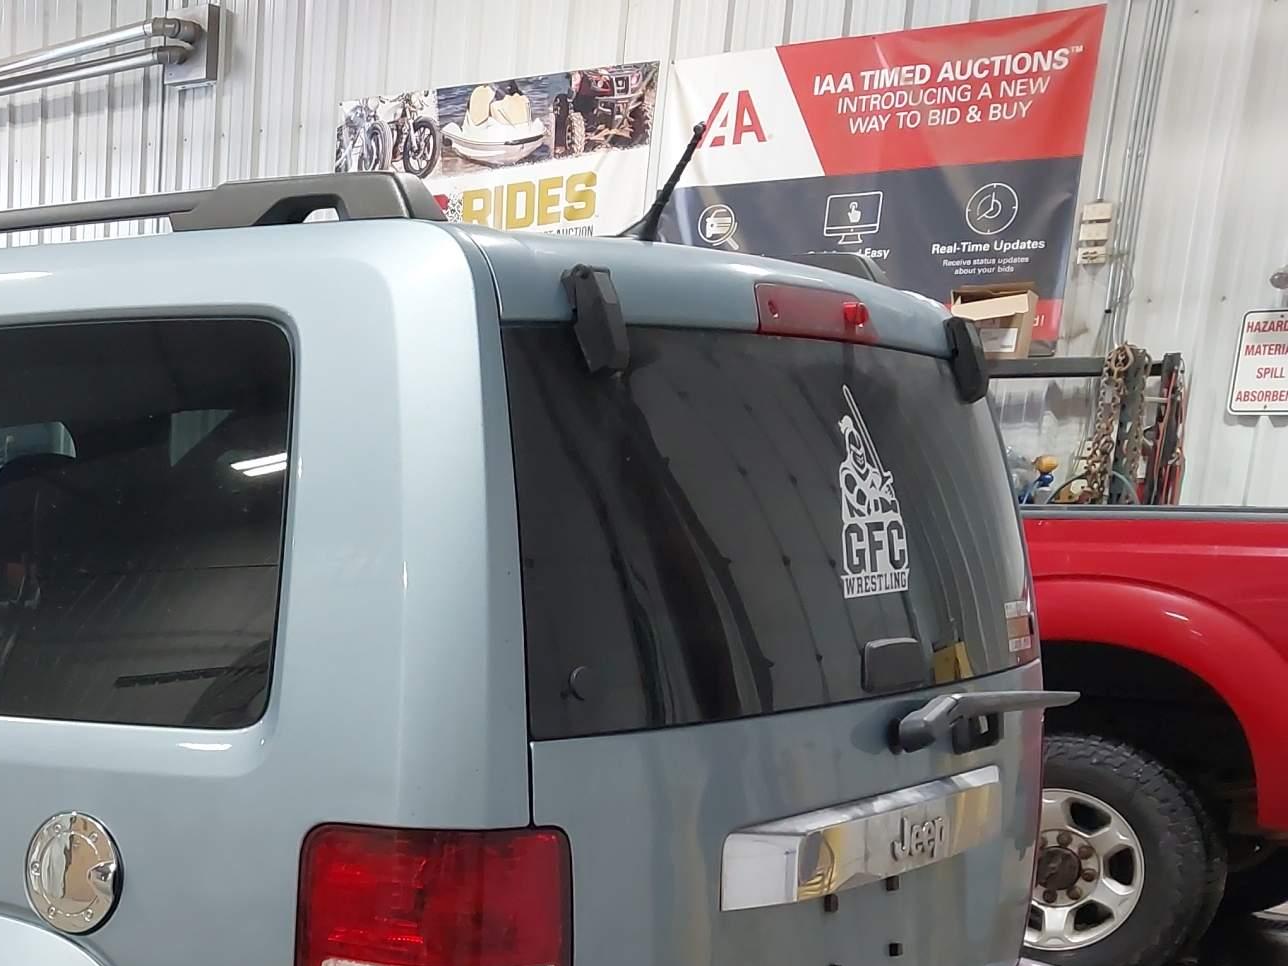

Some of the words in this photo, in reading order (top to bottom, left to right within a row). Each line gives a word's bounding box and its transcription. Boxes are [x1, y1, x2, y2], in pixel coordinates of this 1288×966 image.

[813, 72, 854, 96] IAA
[860, 64, 931, 91] TIMED
[837, 84, 972, 114] INTRODUCING
[977, 82, 992, 100] A
[999, 76, 1050, 98] NEW
[849, 114, 891, 134] WAY
[896, 111, 921, 129] TO
[927, 107, 961, 126] BID
[966, 105, 981, 124] &
[988, 101, 1032, 121] BUY
[463, 170, 598, 232] RIDES
[864, 247, 890, 260] Easy
[931, 241, 991, 255] Real-Time
[993, 239, 1046, 253] Updates
[942, 258, 972, 267] Receive
[972, 258, 996, 266] status
[997, 256, 1030, 265] updates
[954, 266, 976, 275] about
[977, 266, 996, 275] your
[997, 265, 1014, 273] bids
[1255, 367, 1286, 379] SPILL
[1235, 390, 1288, 402] ABSORBE
[844, 521, 906, 574] GFC
[844, 571, 907, 596] WRESTLING
[890, 816, 944, 861] Jeep
